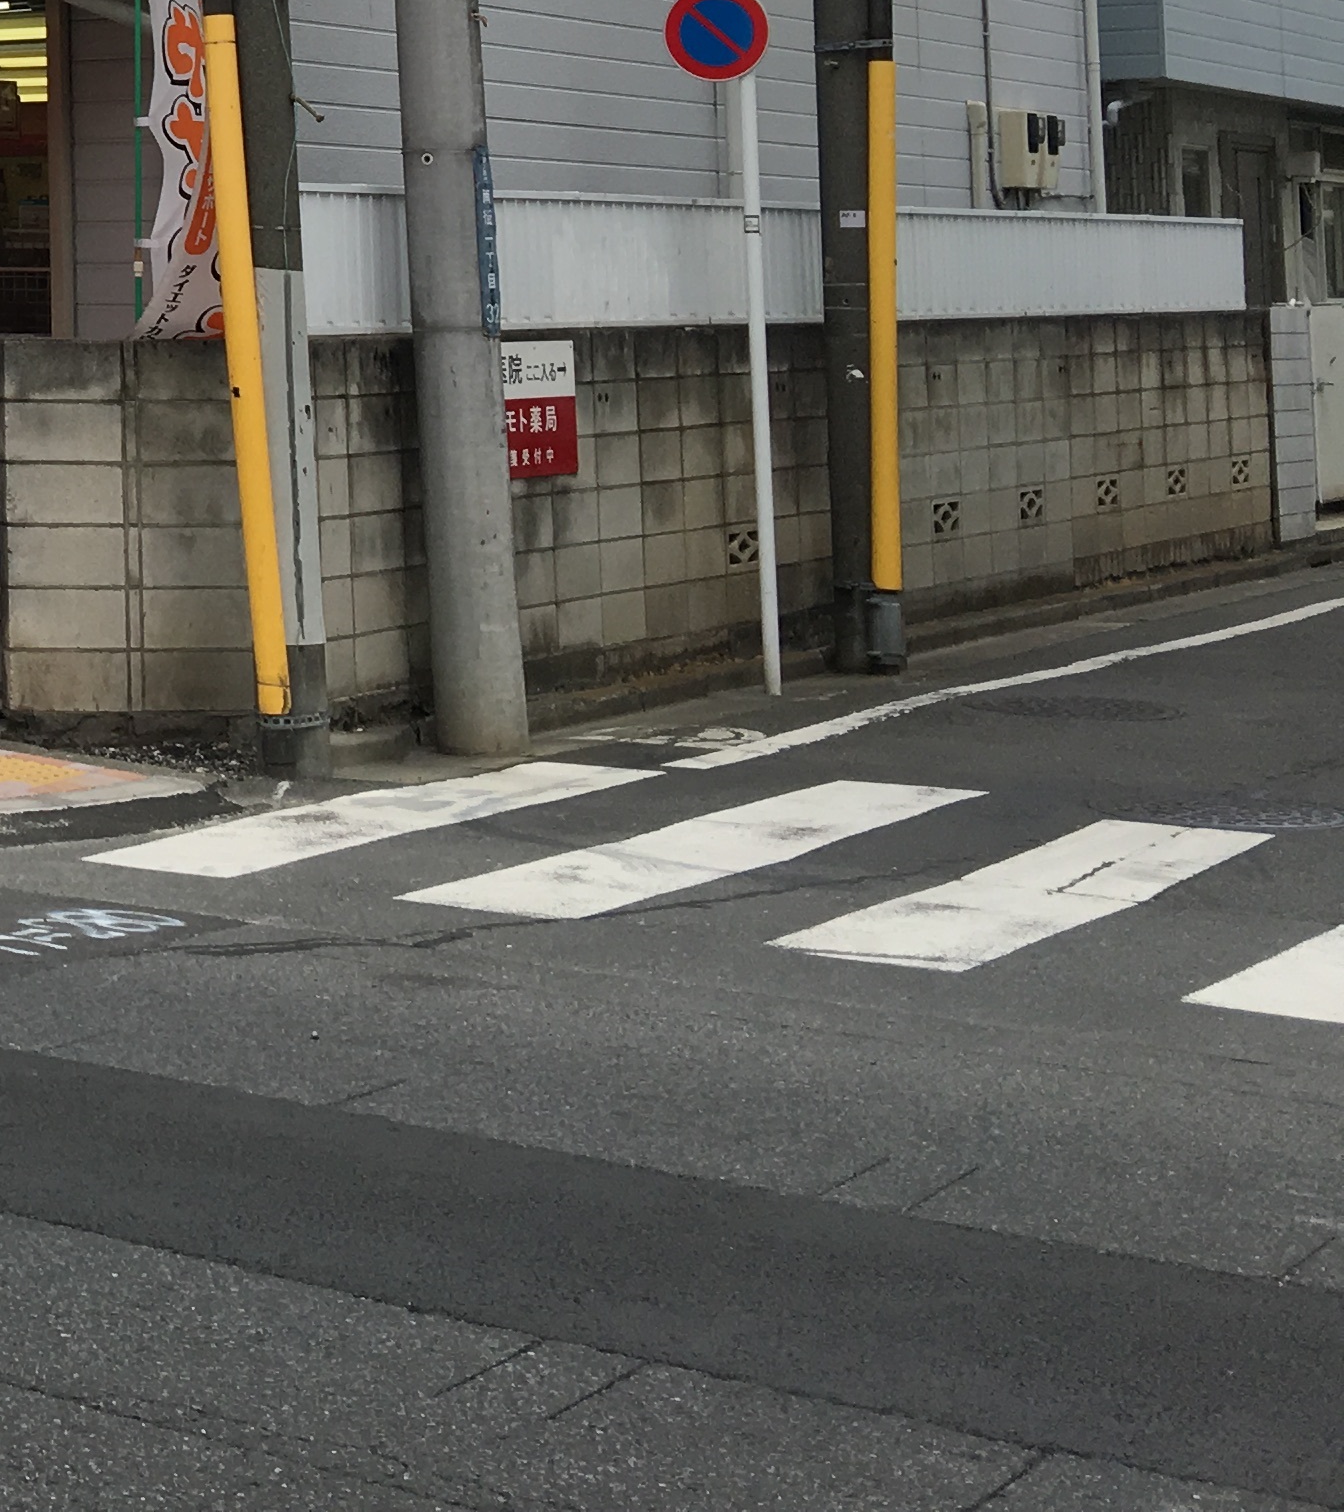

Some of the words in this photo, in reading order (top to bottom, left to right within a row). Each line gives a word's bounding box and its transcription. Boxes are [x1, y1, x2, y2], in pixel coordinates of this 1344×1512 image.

[140, 264, 197, 339] ダイエットカ
[526, 363, 557, 382] ここ入る
